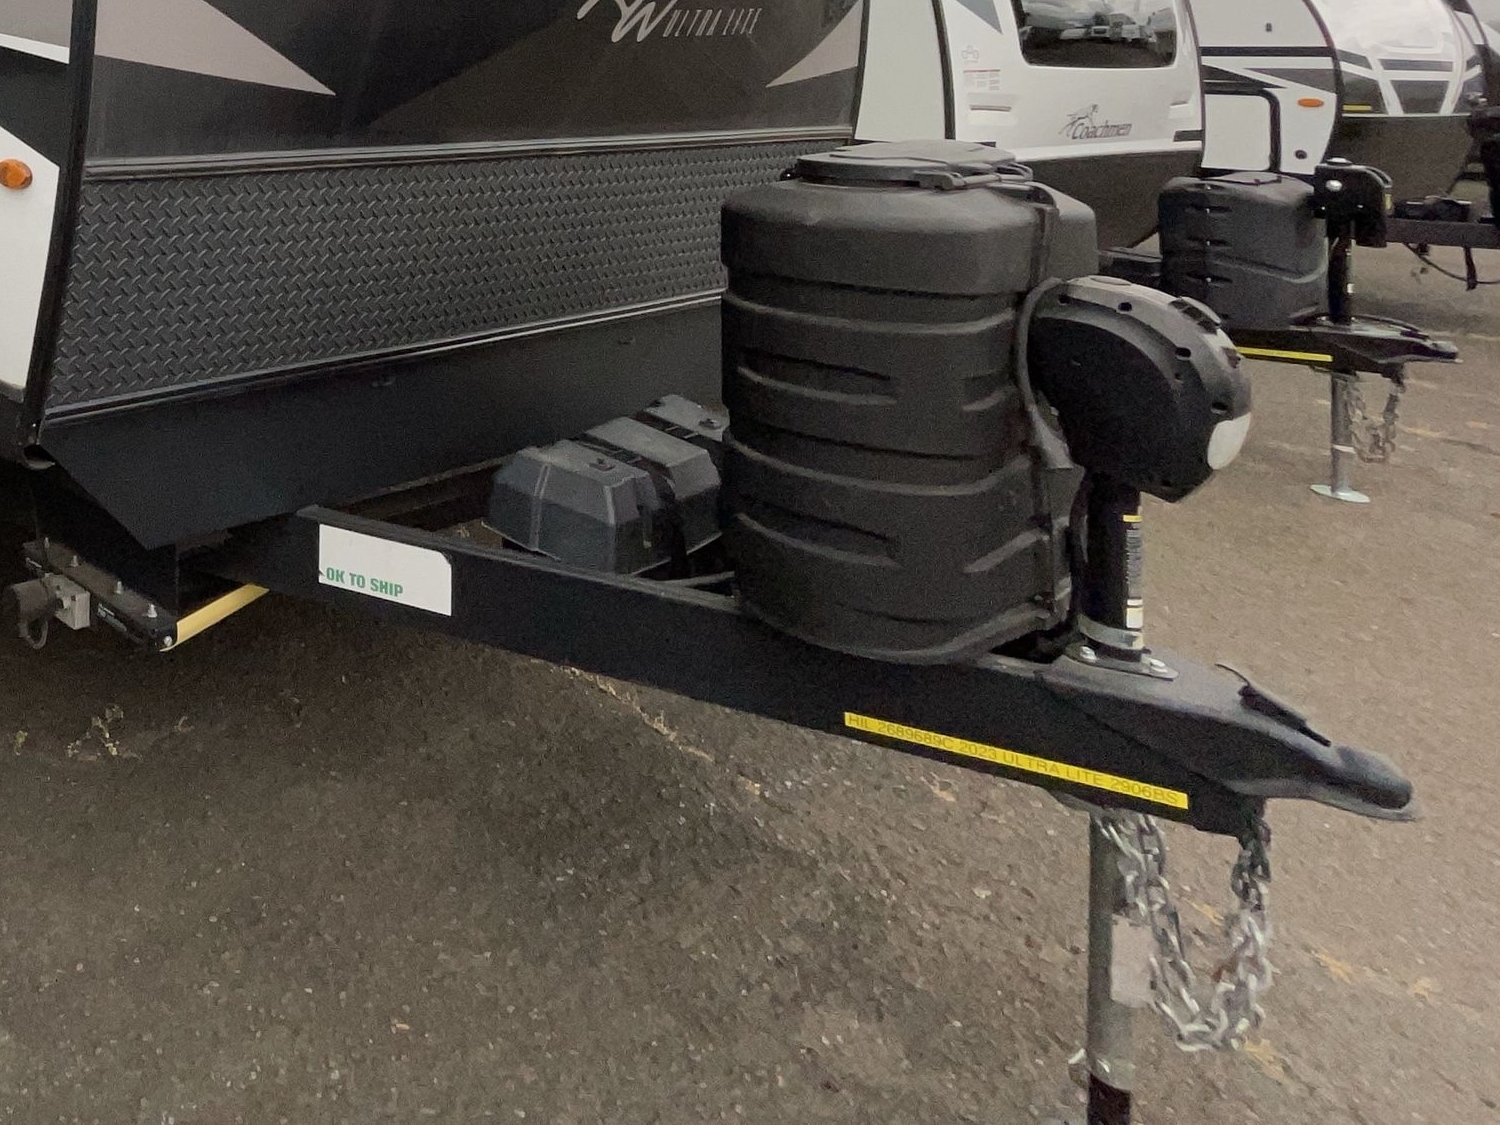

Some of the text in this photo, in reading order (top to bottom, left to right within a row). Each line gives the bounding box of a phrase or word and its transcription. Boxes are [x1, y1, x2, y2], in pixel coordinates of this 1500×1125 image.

[1071, 119, 1132, 140] Coachmen
[326, 567, 404, 597] OK TO SHIP
[959, 741, 997, 760] 2023
[1003, 752, 1060, 774] ULTRA
[1066, 765, 1103, 785] LITE
